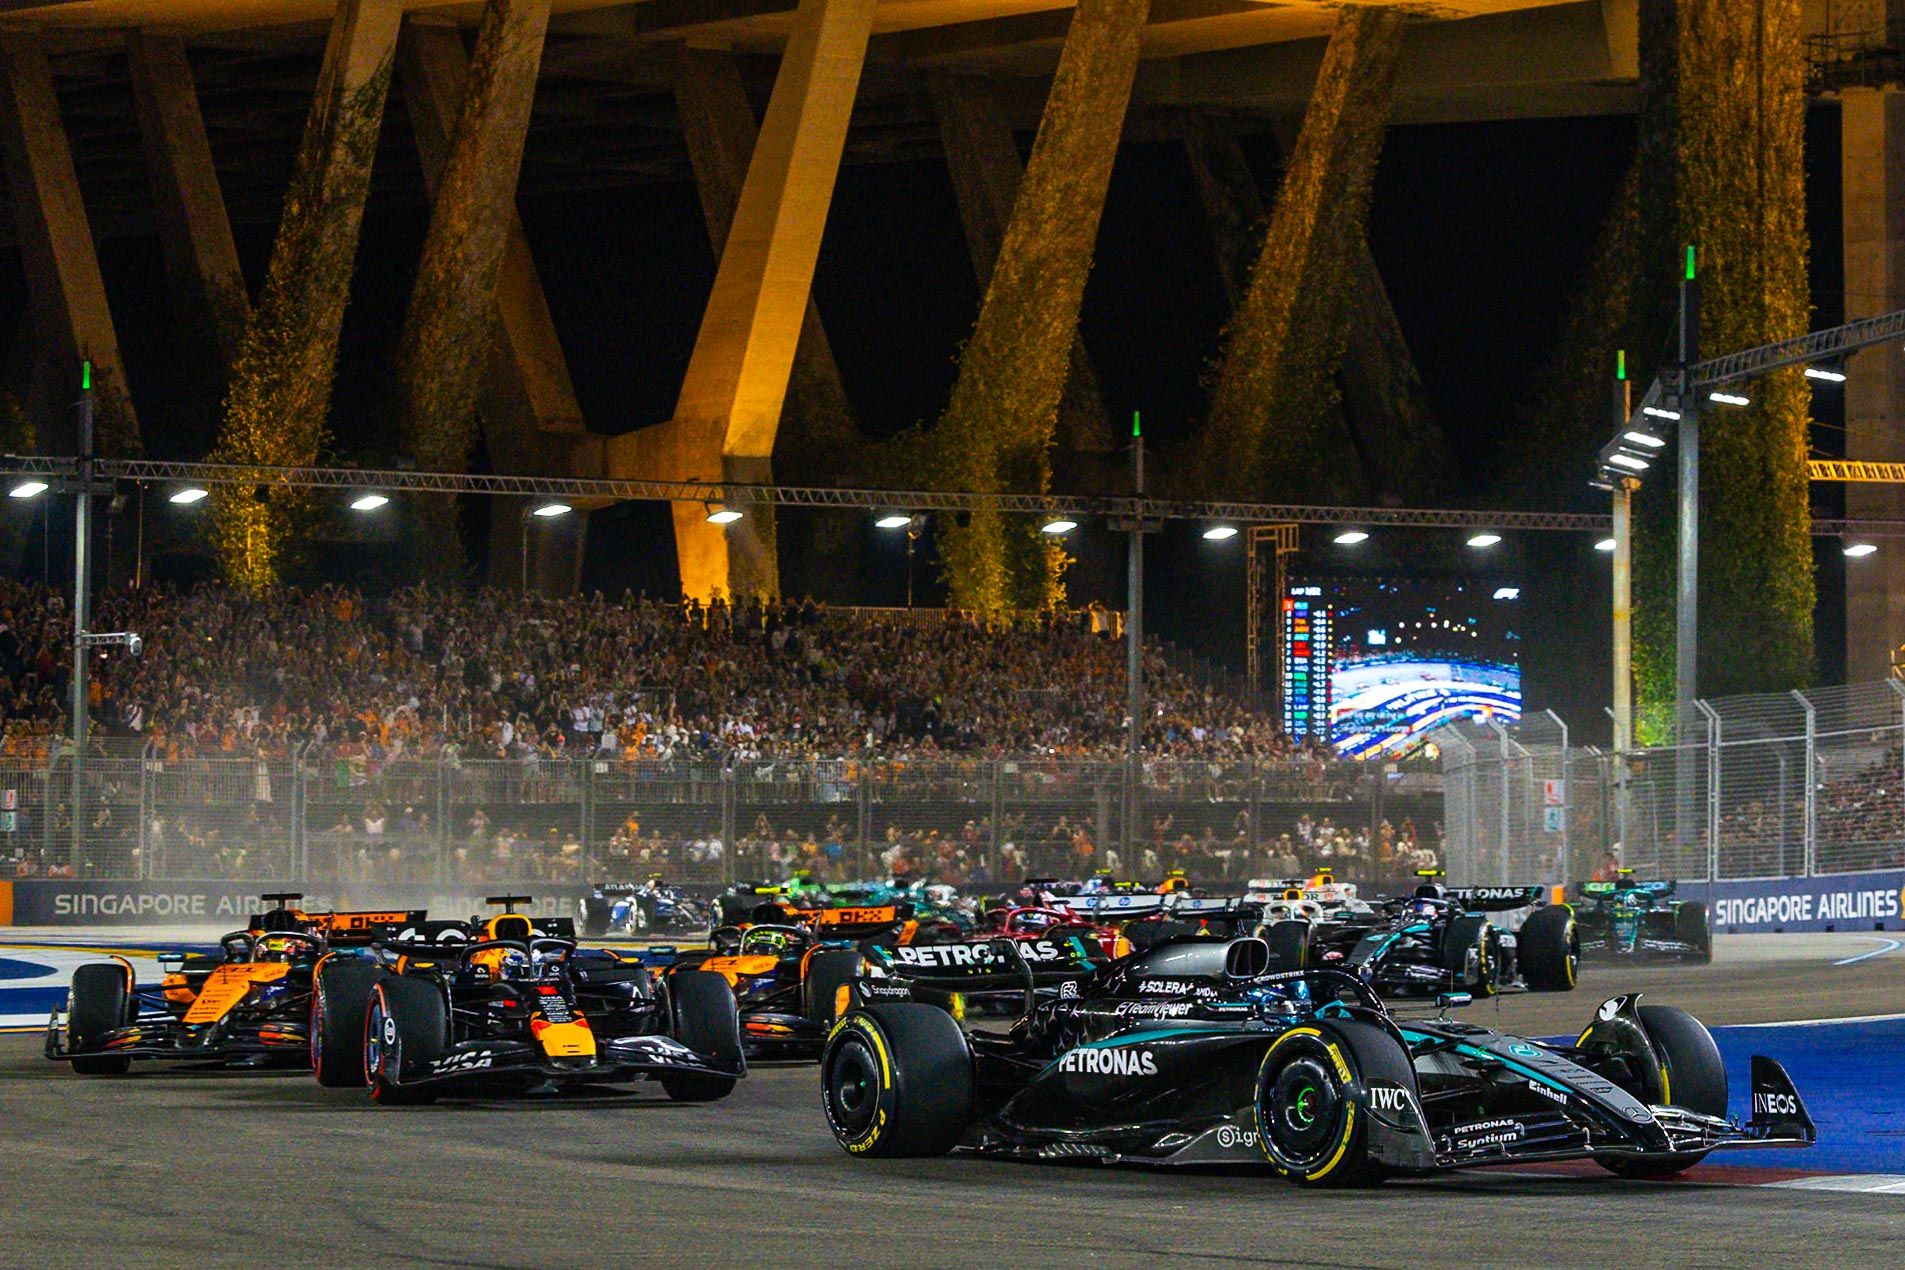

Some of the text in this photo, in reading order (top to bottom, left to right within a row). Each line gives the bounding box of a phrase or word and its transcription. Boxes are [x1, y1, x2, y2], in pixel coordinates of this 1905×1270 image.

[55, 894, 205, 916] SINGAPORE
[1716, 889, 1898, 926] SINGAPORE AIRLINES
[898, 941, 1059, 966] PETROAS
[1256, 970, 1305, 982] CROWDSTRIKE
[871, 985, 911, 999] Snapdragon
[1146, 982, 1187, 994] SOLERA
[1128, 1002, 1193, 1016] TeamViewer
[1059, 1048, 1158, 1076] PETRONAS
[1370, 1087, 1405, 1111] IWC
[1529, 1079, 1567, 1106] Einhell
[1753, 1092, 1797, 1114] INEOS
[1454, 1119, 1514, 1135] PETRONAS
[1457, 1131, 1517, 1150] Syntium
